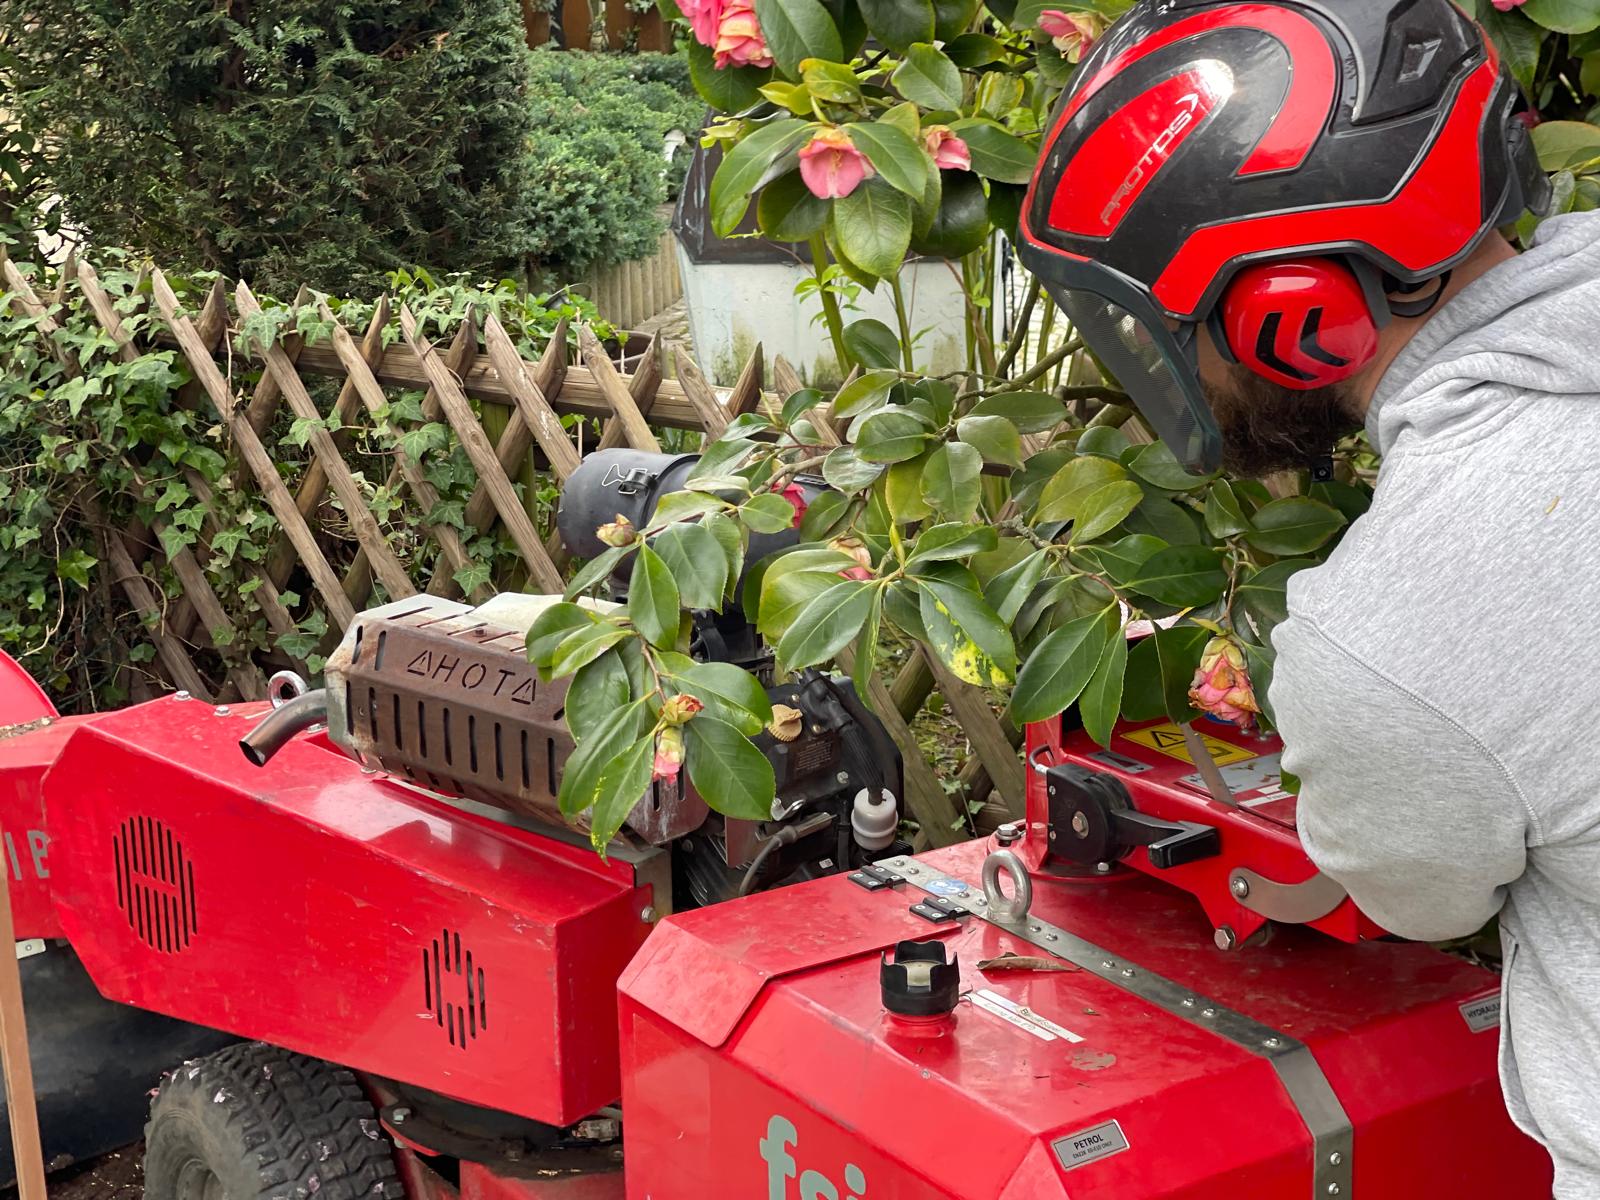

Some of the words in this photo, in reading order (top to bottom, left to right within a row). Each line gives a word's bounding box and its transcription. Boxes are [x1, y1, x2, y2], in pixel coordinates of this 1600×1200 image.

[1101, 109, 1193, 226] PROTOS
[432, 654, 516, 697] HOT
[1073, 1133, 1104, 1150] PETROL
